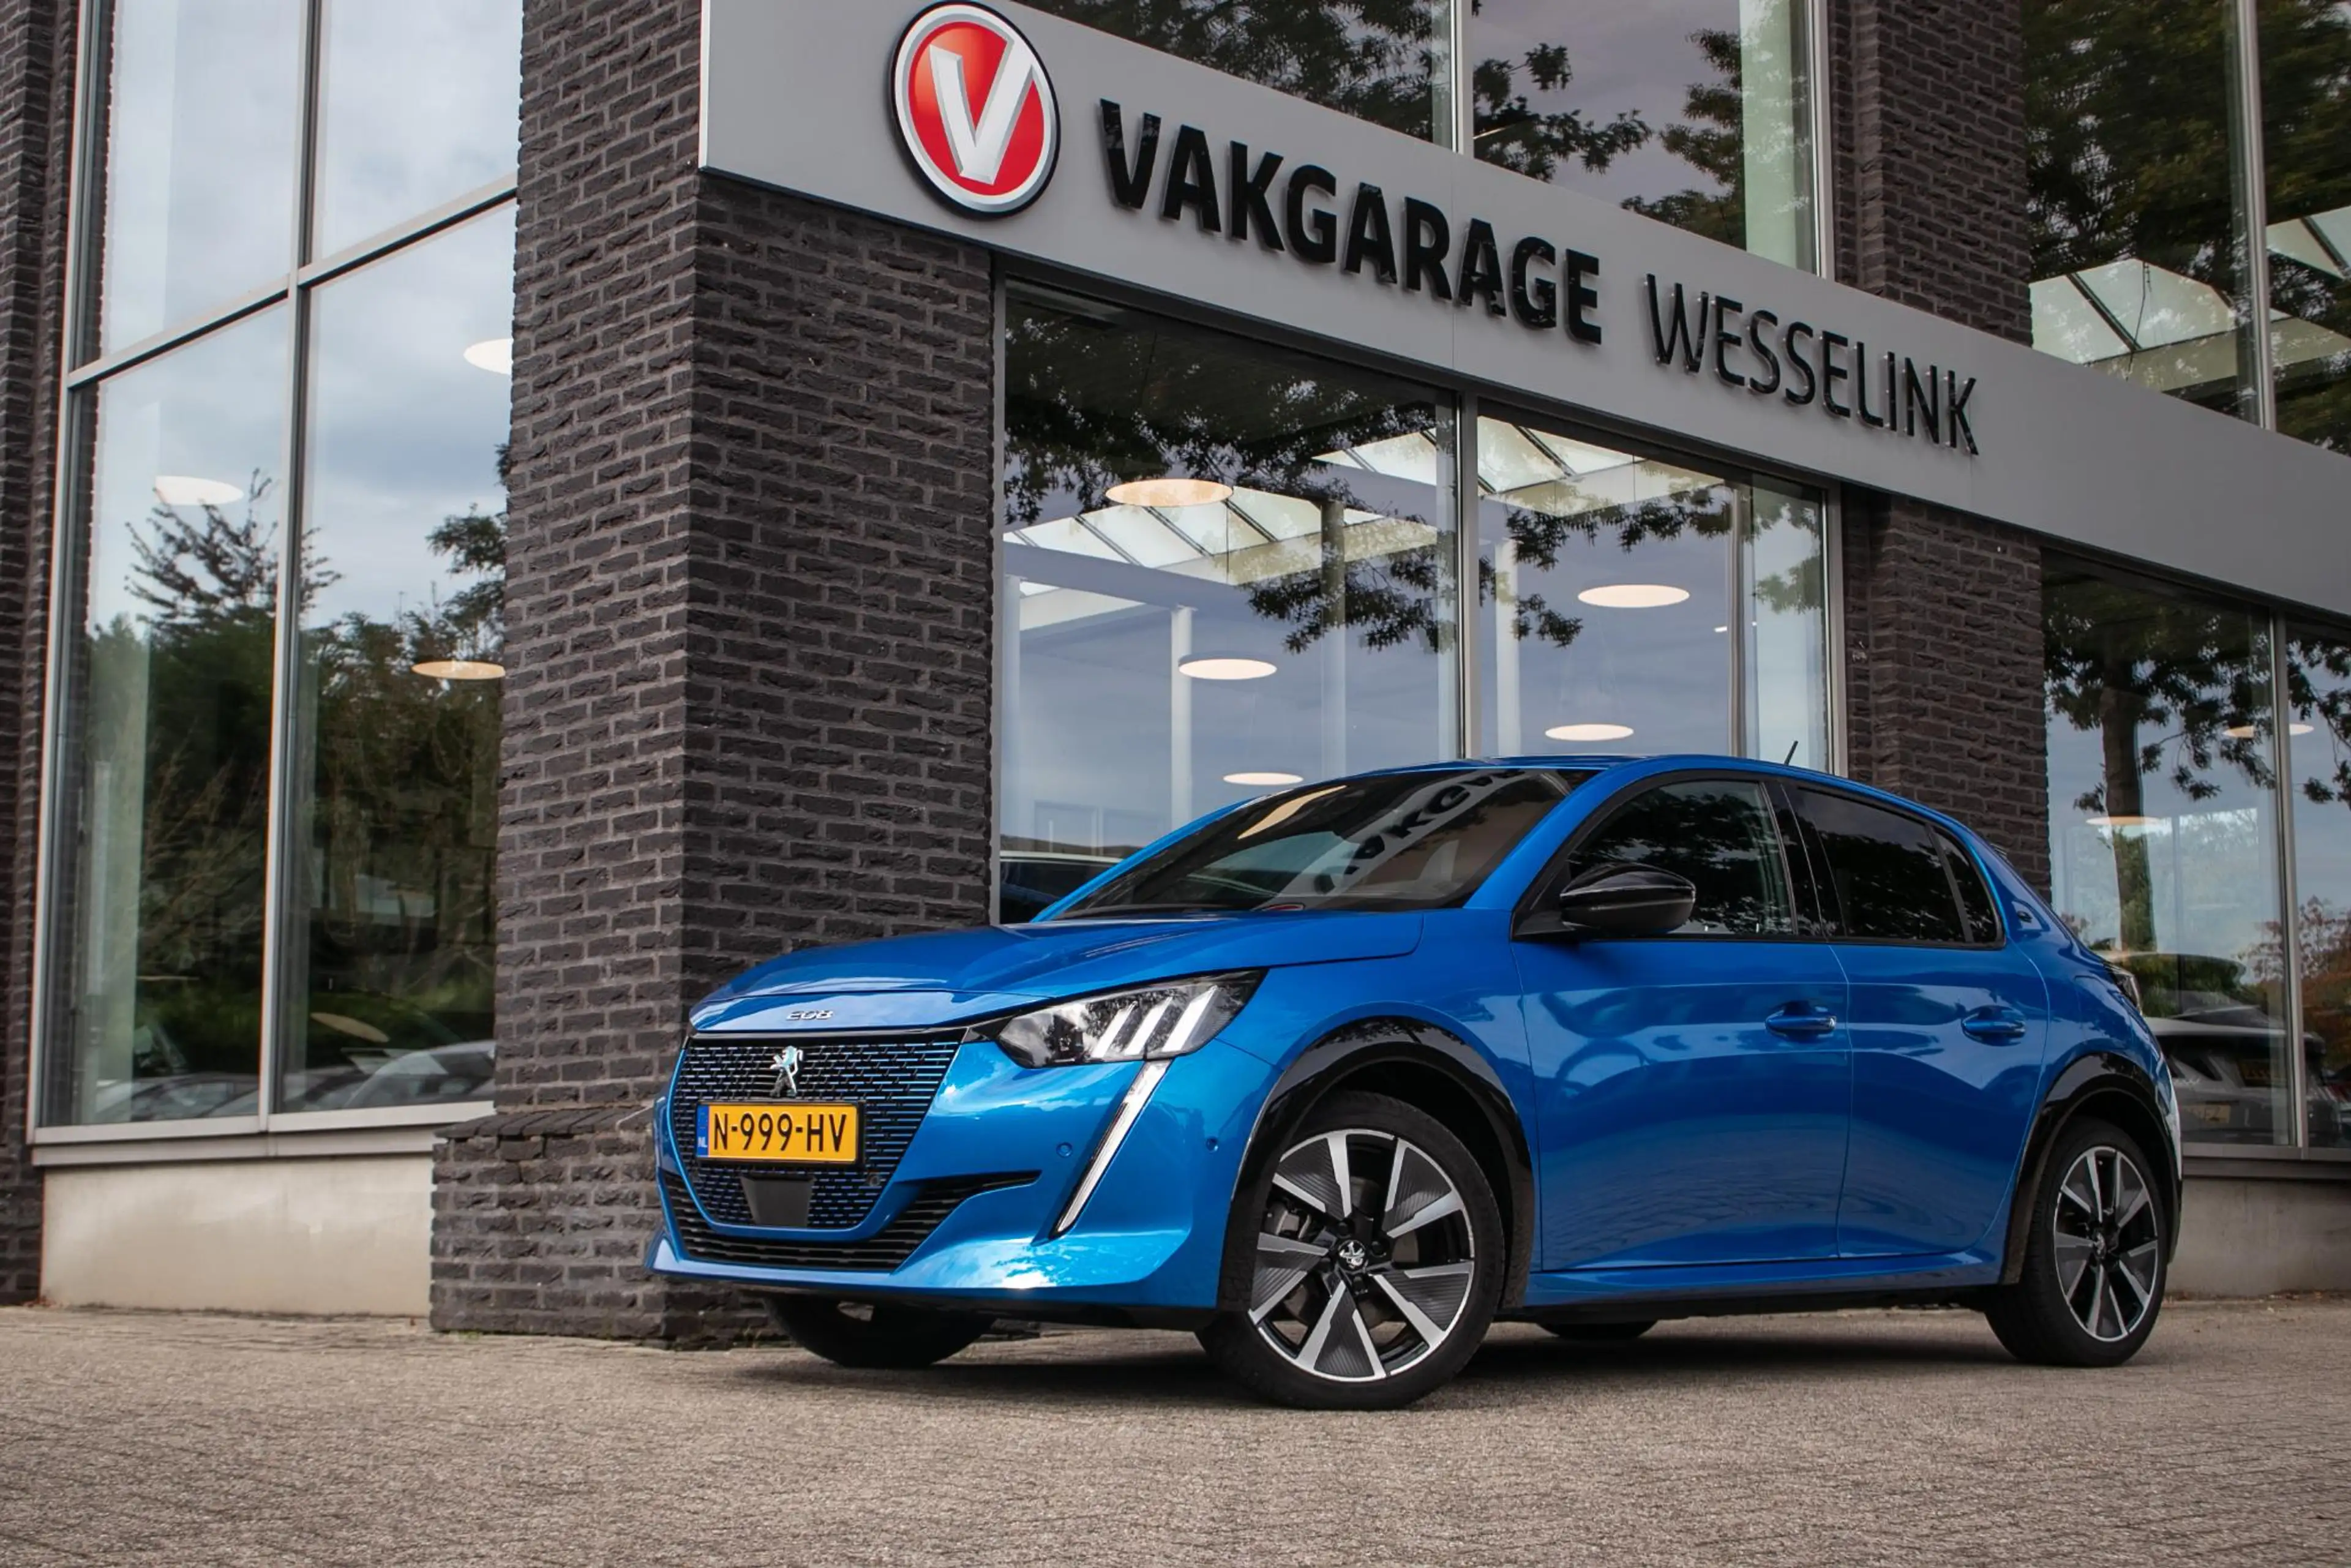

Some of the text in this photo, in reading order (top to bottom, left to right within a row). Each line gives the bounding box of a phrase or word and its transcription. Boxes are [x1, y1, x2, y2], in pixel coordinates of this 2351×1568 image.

[929, 37, 1038, 186] V
[1100, 97, 1979, 455] VAKGARAGE WESSELINK
[786, 1010, 833, 1021] 208
[714, 1112, 847, 1152] N-999-HV
